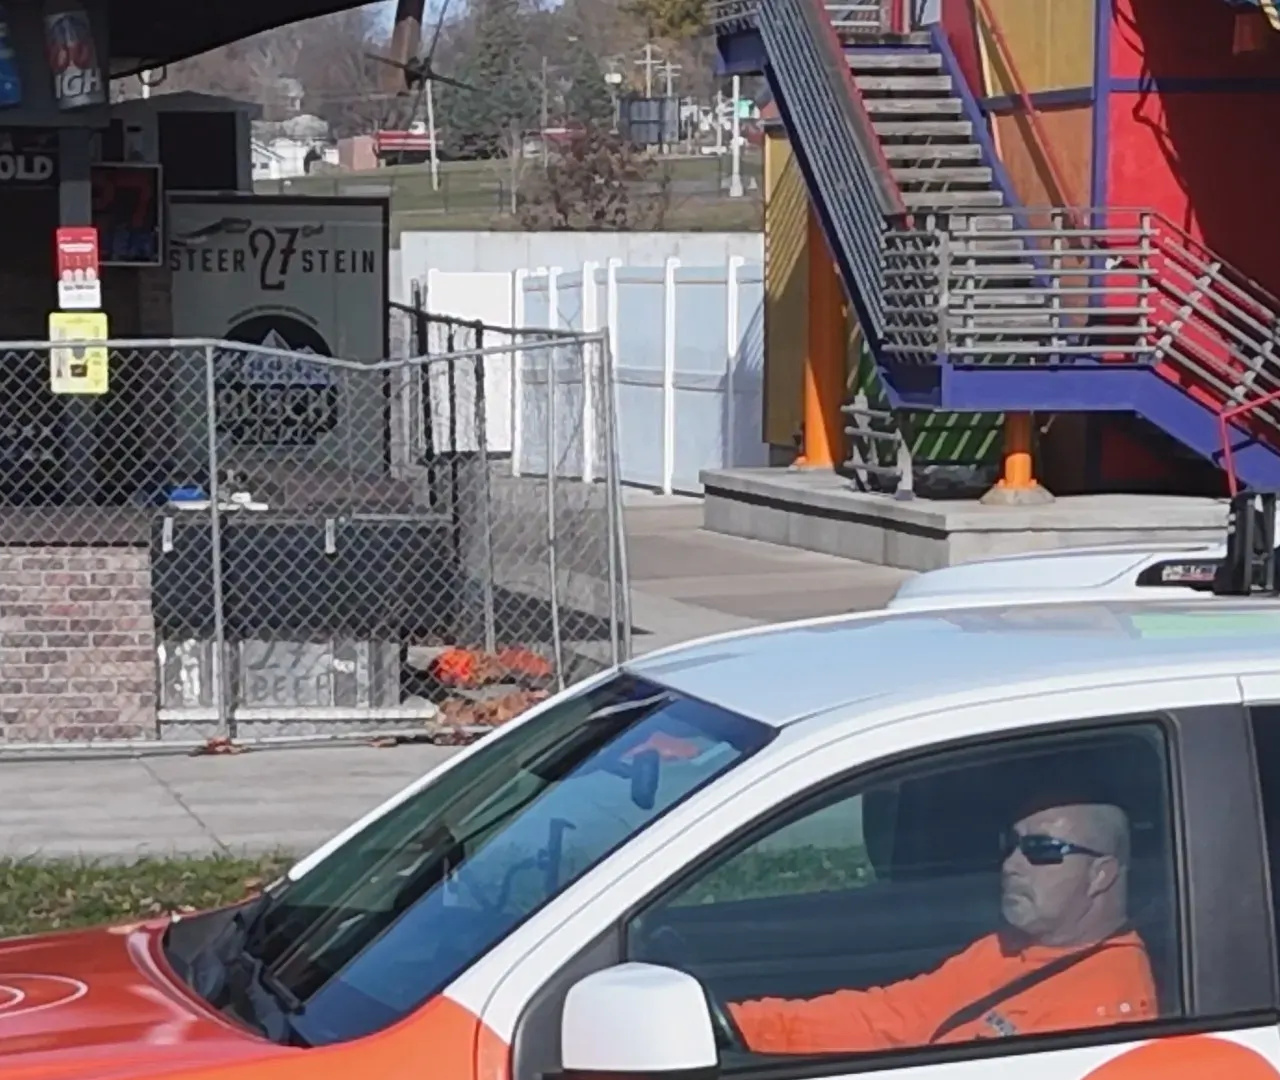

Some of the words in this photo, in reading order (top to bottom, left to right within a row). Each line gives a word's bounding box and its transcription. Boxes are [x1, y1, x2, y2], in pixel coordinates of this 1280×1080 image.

[171, 249, 245, 272] STEER
[249, 228, 300, 290] 27
[302, 250, 375, 273] STEIN
